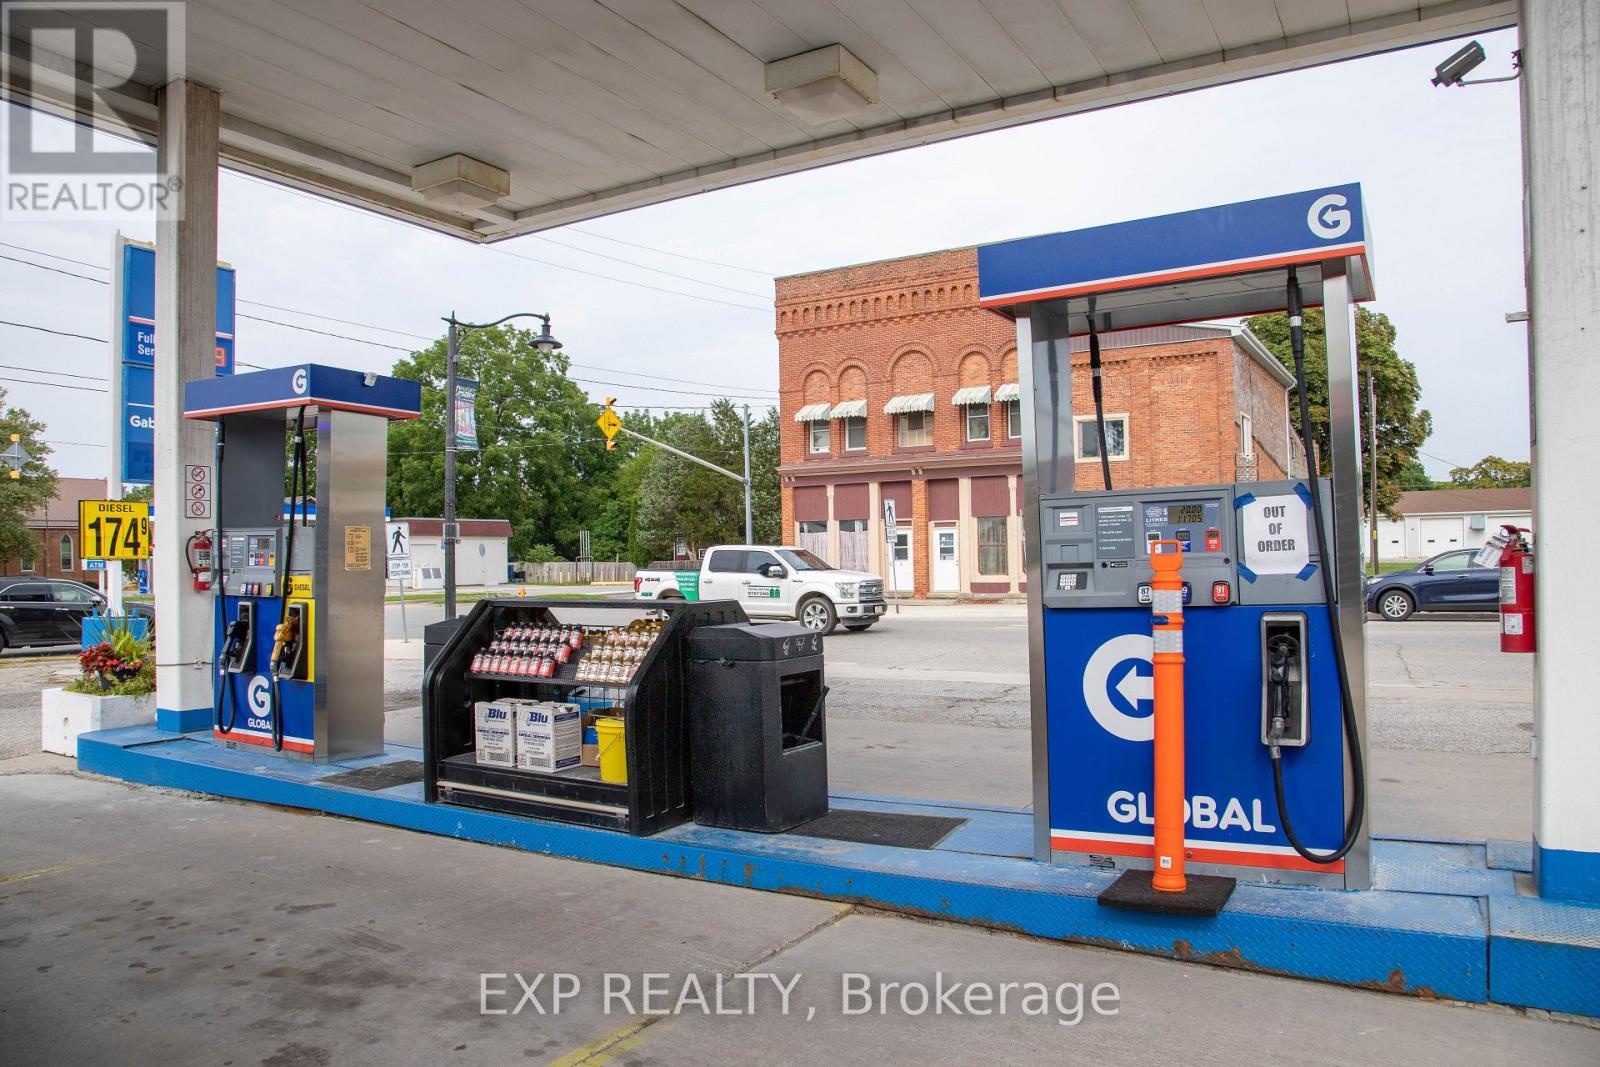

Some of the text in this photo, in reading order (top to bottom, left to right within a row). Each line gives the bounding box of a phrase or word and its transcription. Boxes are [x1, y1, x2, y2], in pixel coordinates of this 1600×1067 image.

[137, 344, 155, 356] Ser
[130, 415, 155, 429] Gab
[98, 503, 135, 512] DIESEL
[1263, 505, 1286, 518] OUT
[1268, 523, 1283, 534] OF
[1257, 539, 1296, 552] ORDER
[1141, 587, 1150, 595] 87
[1216, 586, 1225, 594] 91
[487, 708, 507, 720] Blu
[529, 711, 548, 723] Blu
[247, 717, 273, 730] GLOBA
[1107, 790, 1276, 833] GLBAL
